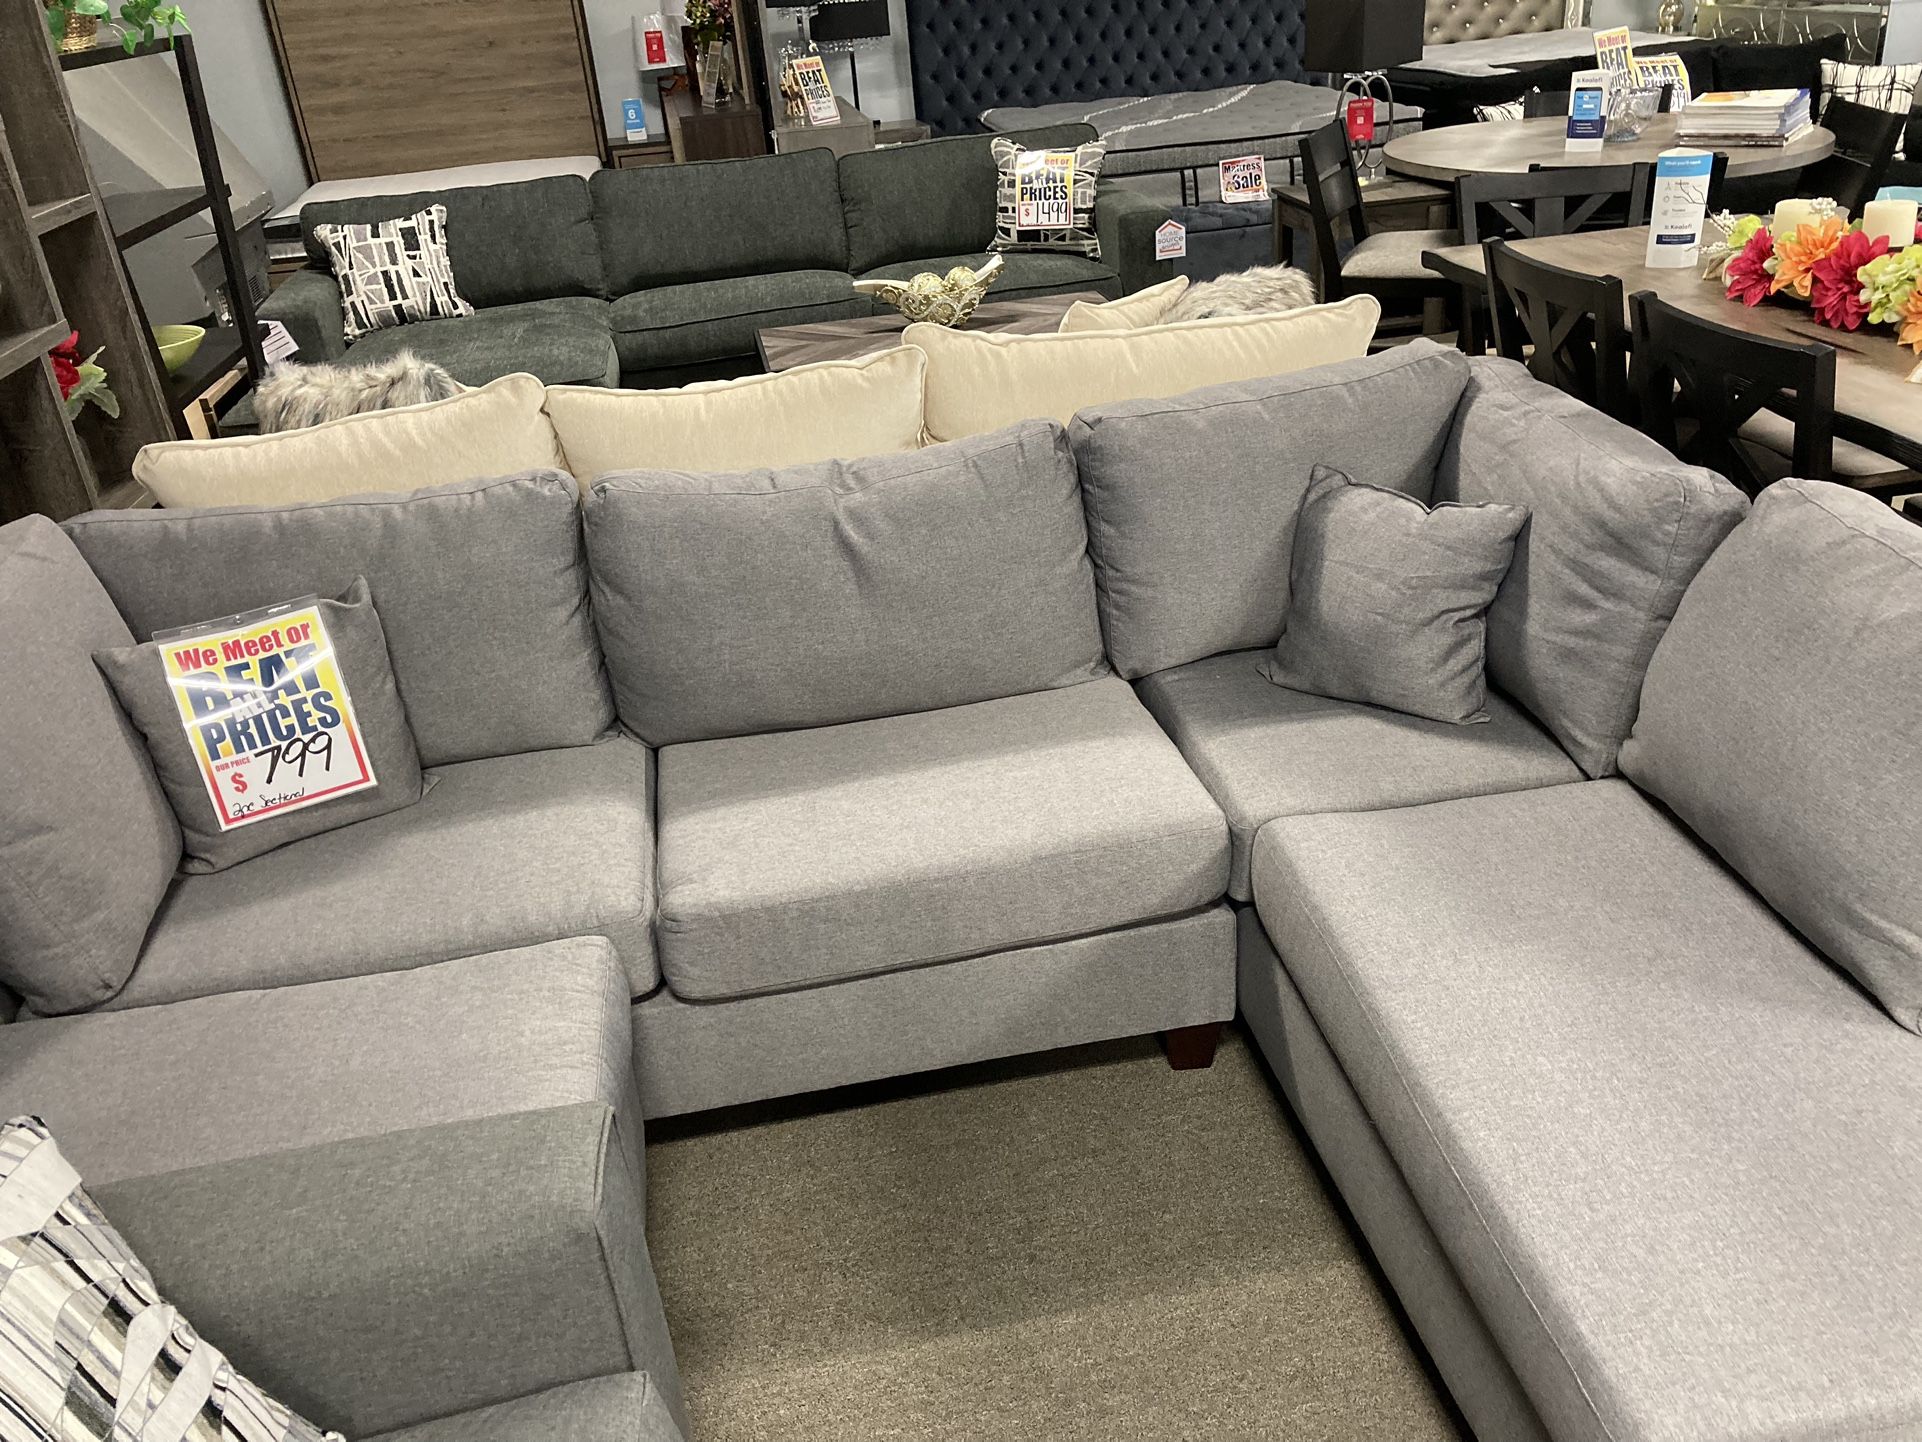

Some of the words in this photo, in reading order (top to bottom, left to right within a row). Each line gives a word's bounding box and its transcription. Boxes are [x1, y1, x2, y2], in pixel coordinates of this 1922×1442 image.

[1600, 46, 1628, 70] BEAT
[799, 68, 825, 87] BEAT
[1639, 64, 1680, 78] BEAT
[804, 85, 831, 101] PRICES
[628, 109, 636, 119] 6
[1232, 172, 1262, 191] Sale
[1020, 185, 1068, 202] PRICES
[174, 649, 218, 673] We
[221, 629, 284, 662] Meet
[286, 622, 311, 644] or
[186, 643, 321, 717] BEAT
[200, 690, 342, 762] PRICES
[215, 761, 230, 773] OUR
[230, 756, 251, 770] PRICE
[230, 772, 248, 794] $
[254, 731, 333, 785] 799
